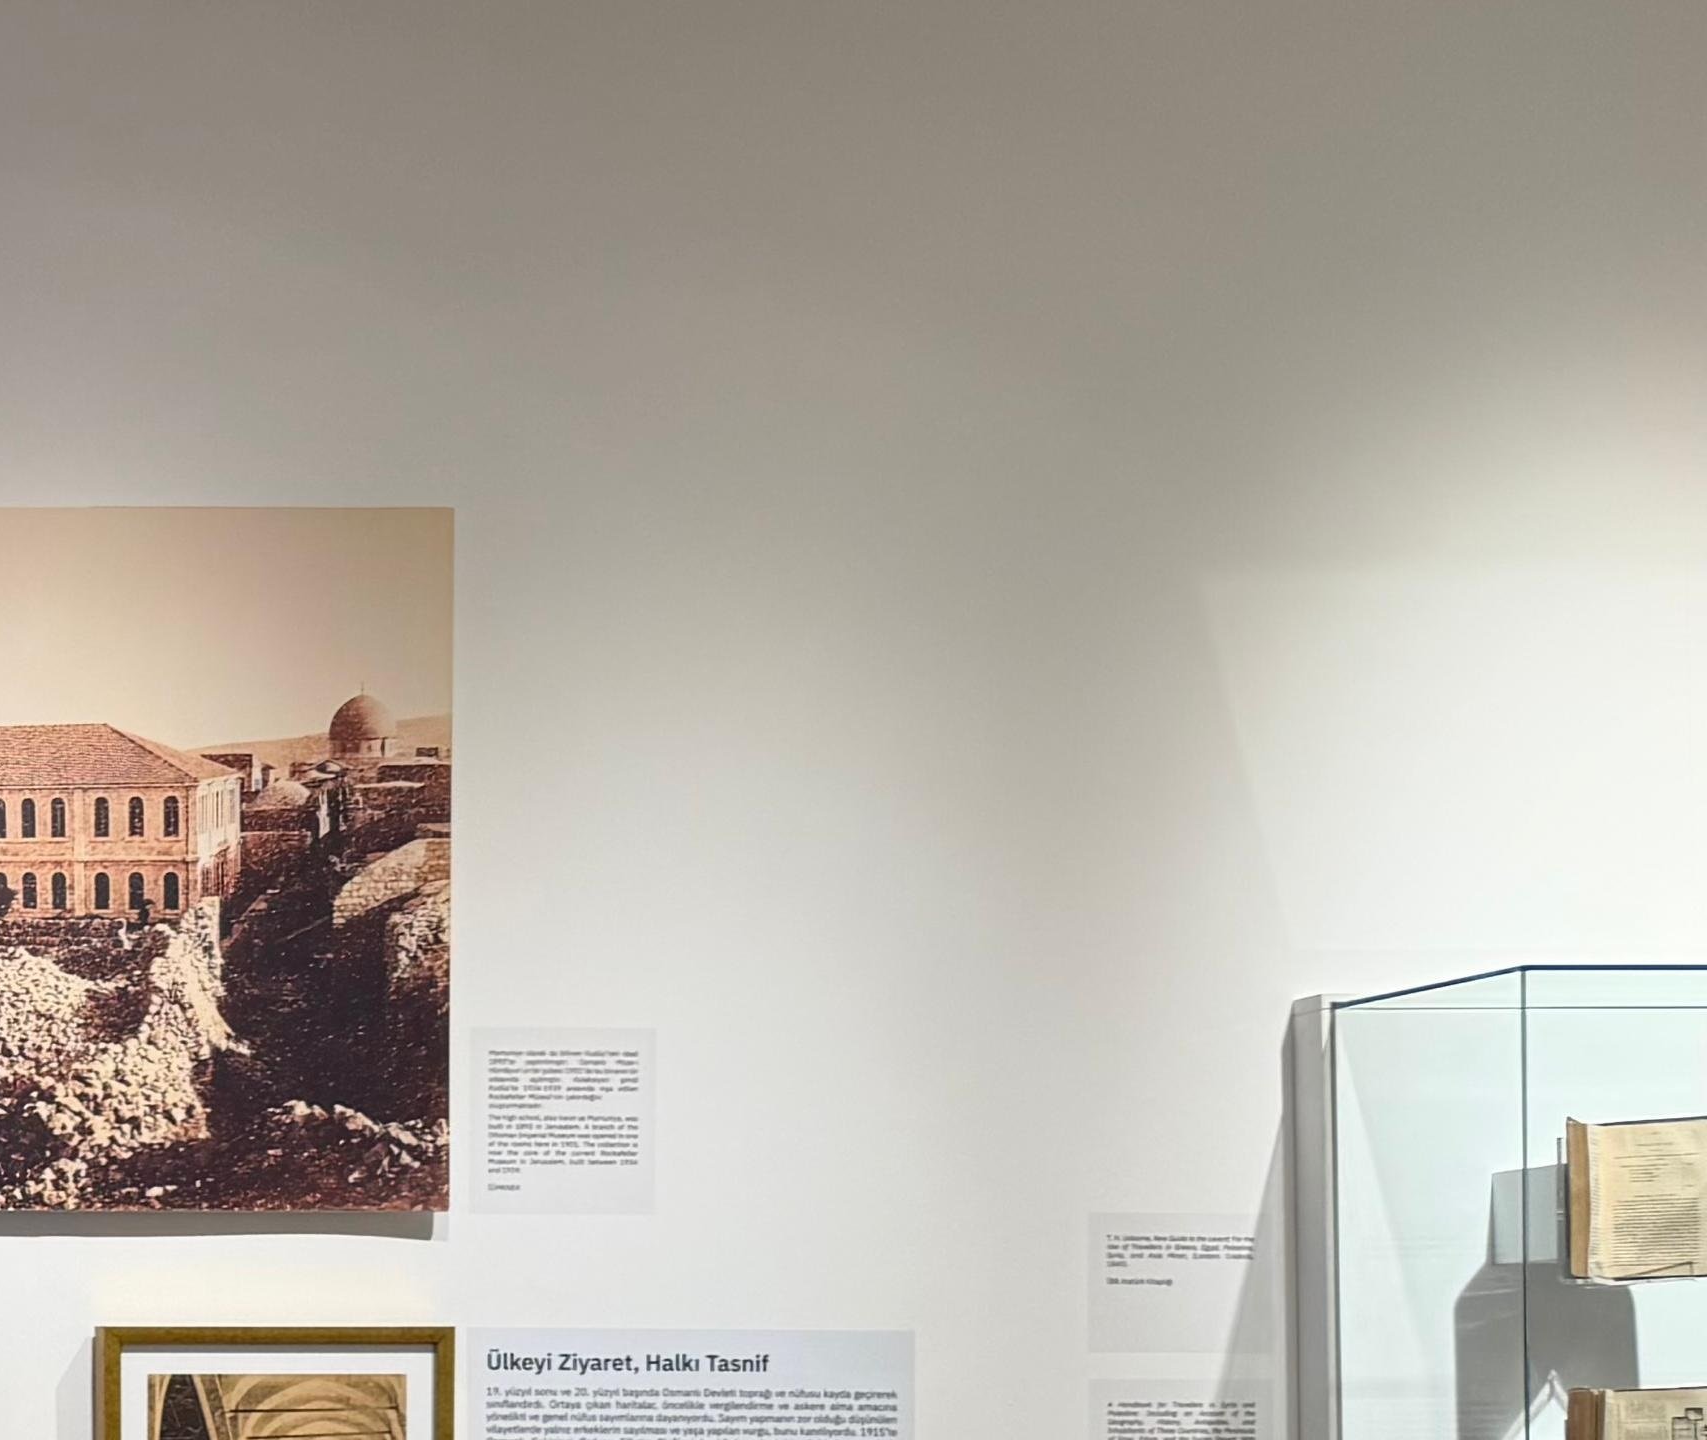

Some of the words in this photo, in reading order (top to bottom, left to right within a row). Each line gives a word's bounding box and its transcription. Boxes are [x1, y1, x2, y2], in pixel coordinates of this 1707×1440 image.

[487, 1348, 552, 1376] Ülkeyi
[557, 1352, 639, 1376] Ziyaret,
[645, 1353, 700, 1372] Halkı
[704, 1353, 769, 1372] Tasnif
